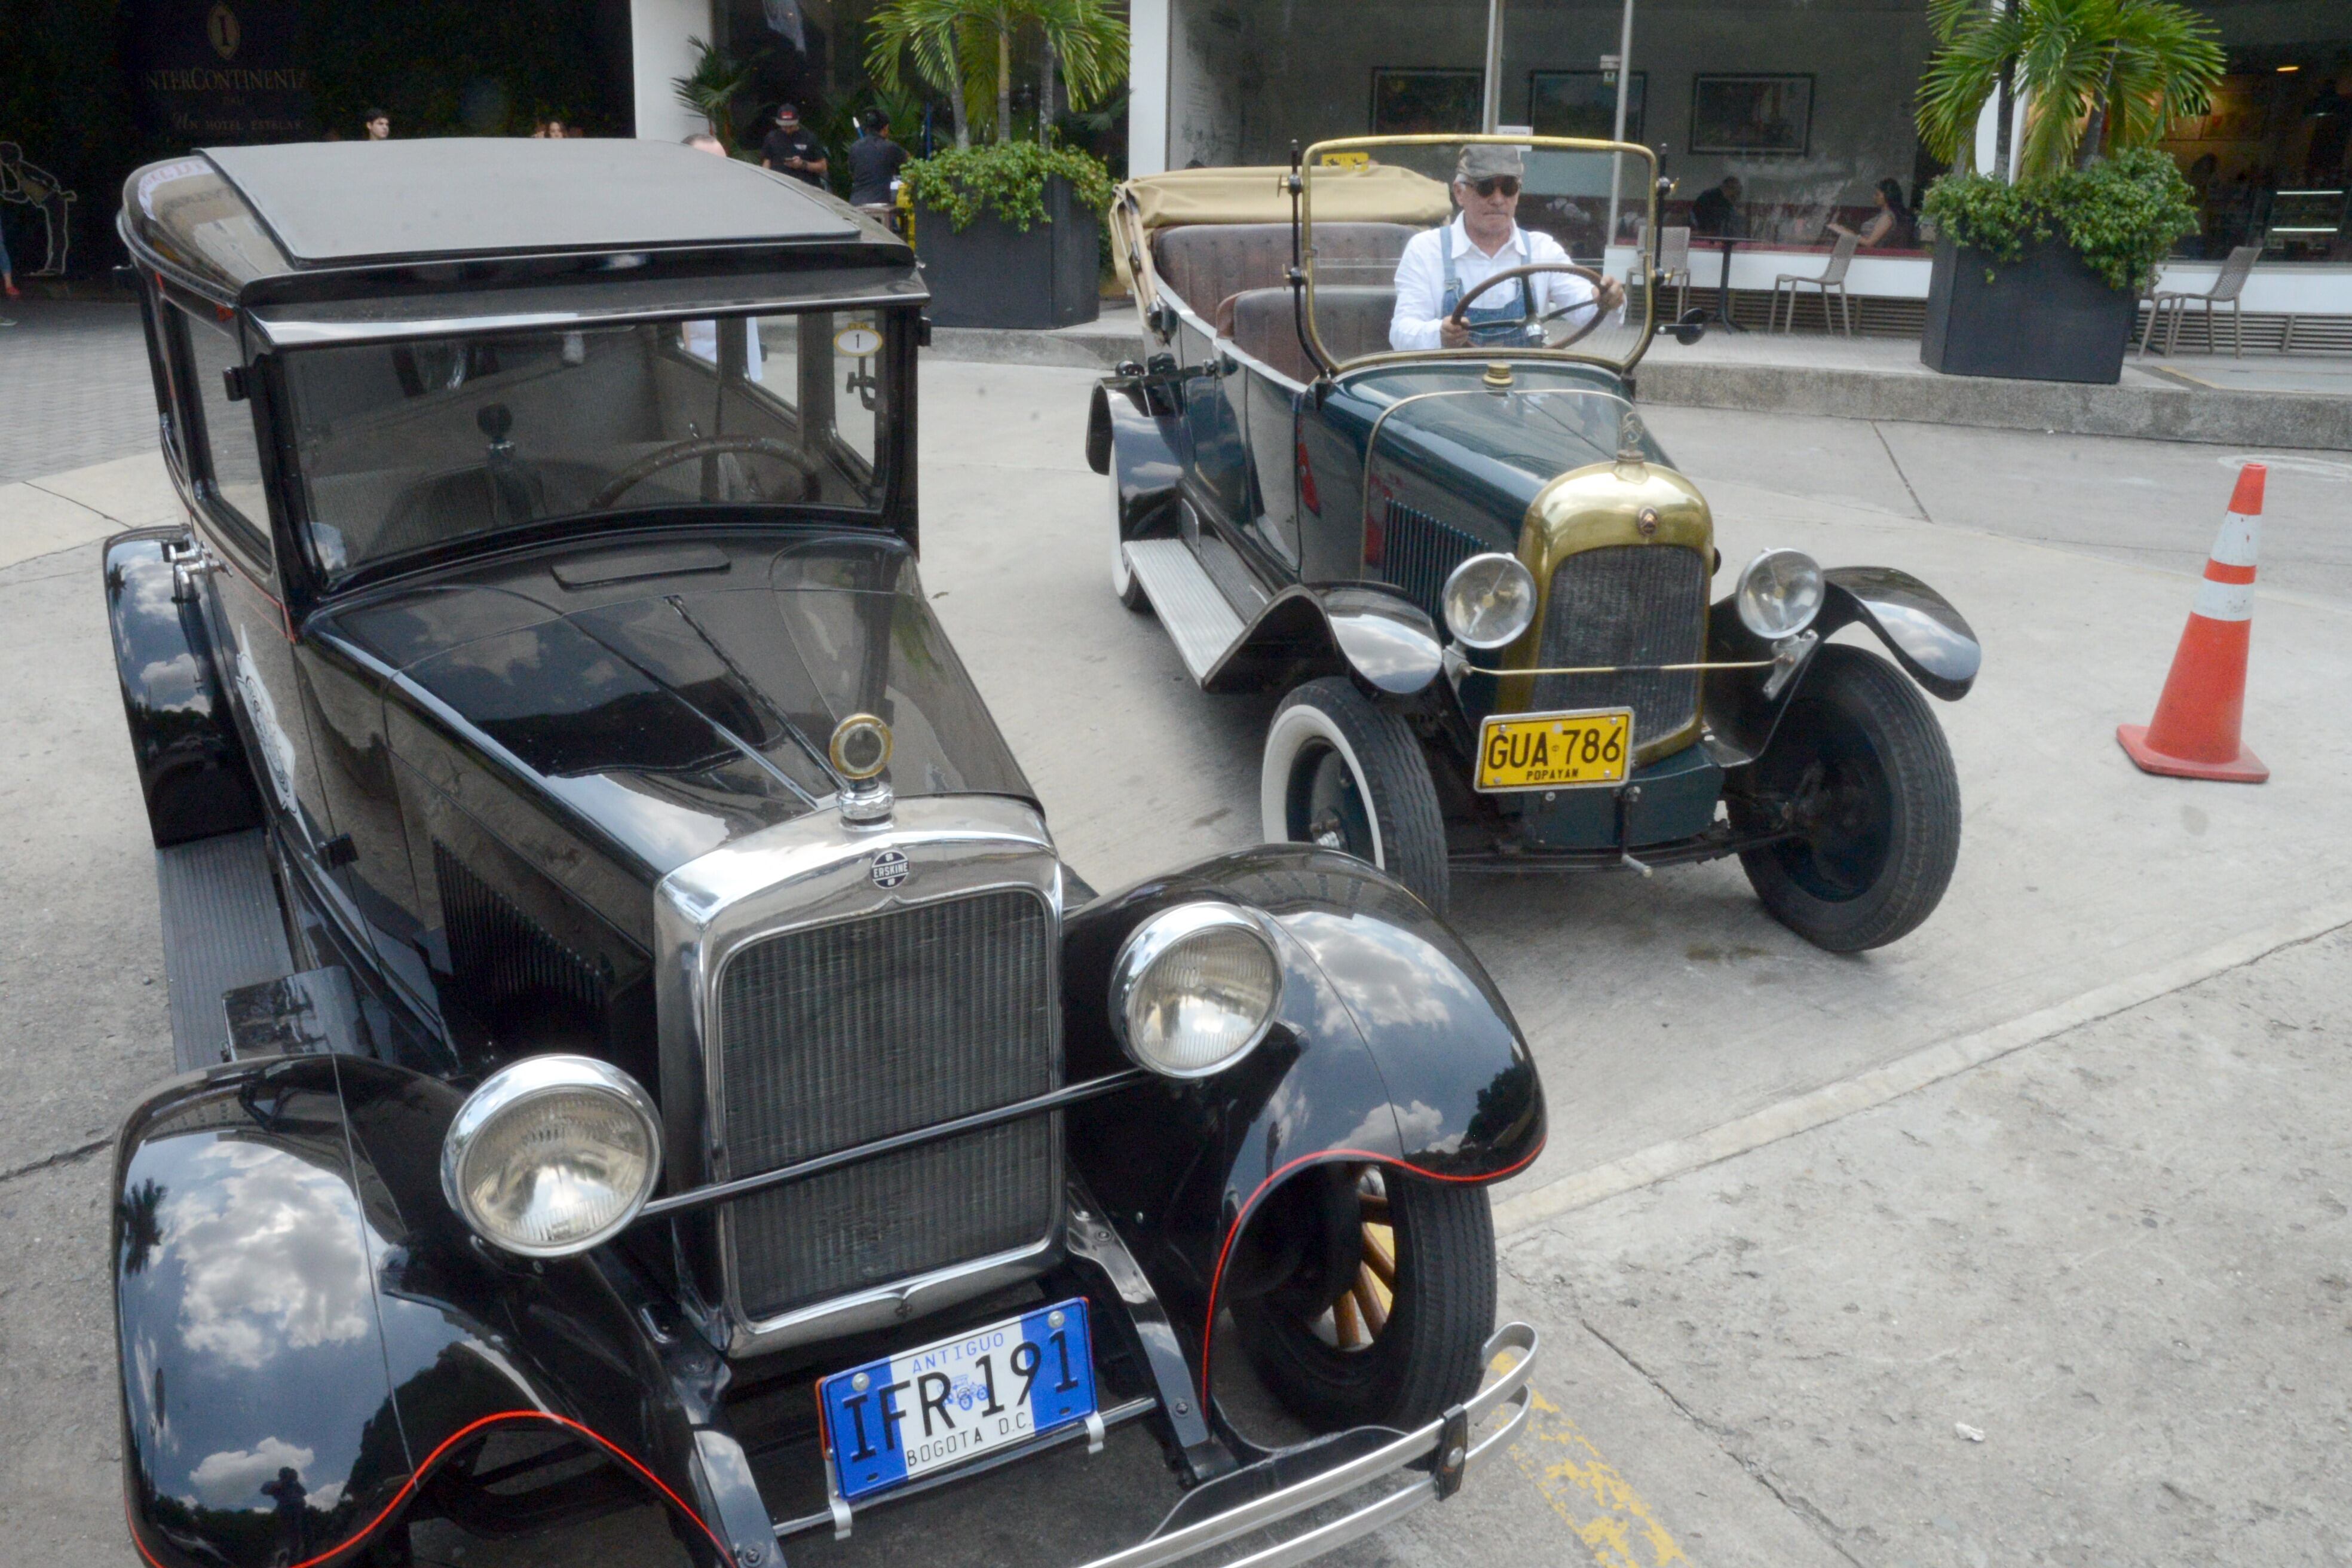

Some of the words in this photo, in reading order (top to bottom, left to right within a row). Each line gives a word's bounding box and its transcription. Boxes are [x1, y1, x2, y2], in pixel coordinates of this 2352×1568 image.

[855, 333, 860, 348] 1
[1526, 768, 1579, 781] POPAYAN
[873, 862, 908, 878] ERSKINE
[912, 1332, 1004, 1374] ANTIGUO
[907, 1429, 984, 1467] BOGOTA
[999, 1411, 1033, 1437] D.C.
